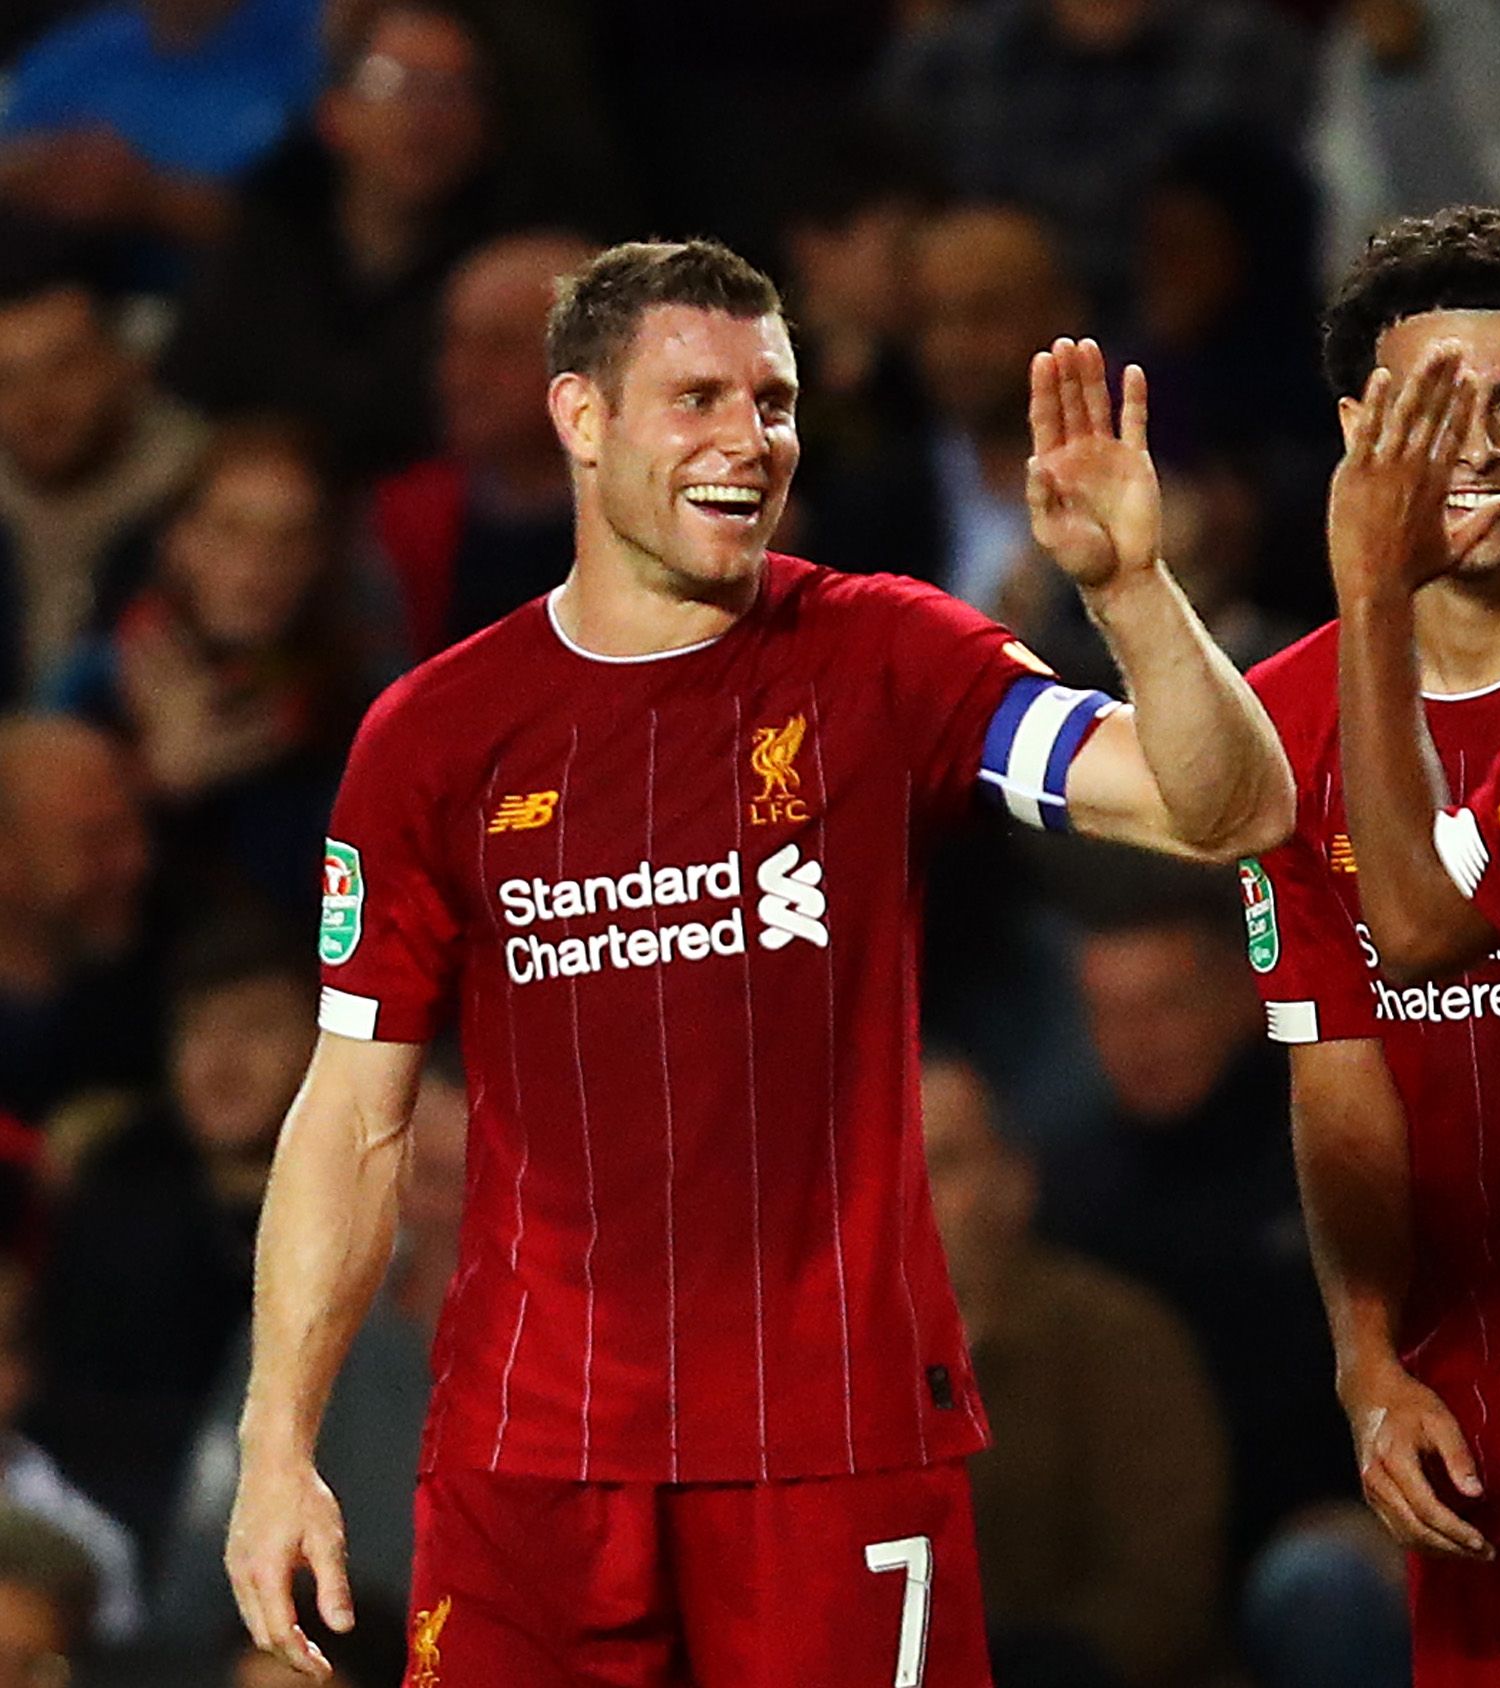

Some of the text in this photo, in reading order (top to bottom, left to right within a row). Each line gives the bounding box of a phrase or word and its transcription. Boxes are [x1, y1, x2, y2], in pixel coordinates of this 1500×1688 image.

[750, 799, 811, 825] LFC
[499, 850, 744, 928] Standard
[504, 906, 747, 986] Chartered
[864, 1534, 934, 1688] 7
